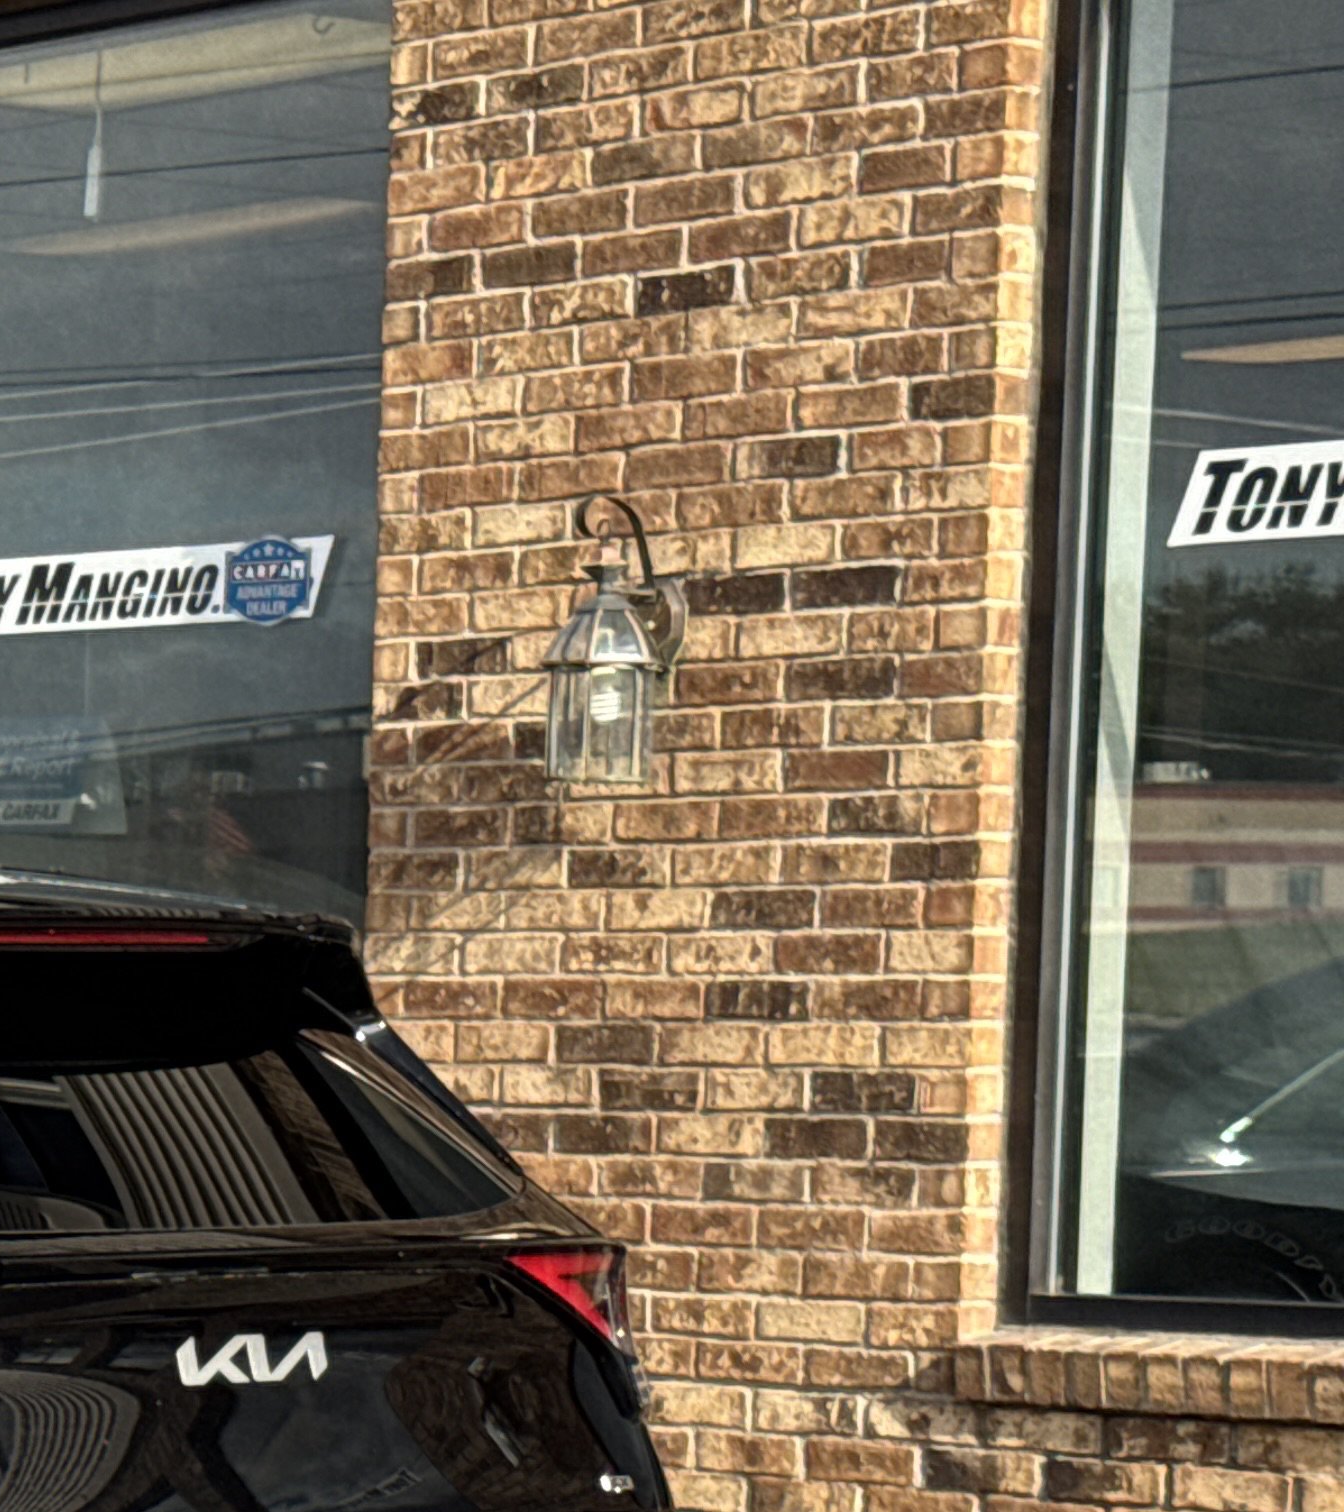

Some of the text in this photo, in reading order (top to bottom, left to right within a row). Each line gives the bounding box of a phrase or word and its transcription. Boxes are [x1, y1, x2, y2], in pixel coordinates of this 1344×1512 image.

[1192, 457, 1344, 535] TONY
[16, 562, 219, 625] MANGINO
[232, 560, 306, 580] CARFAX
[176, 1331, 328, 1386] KIA
